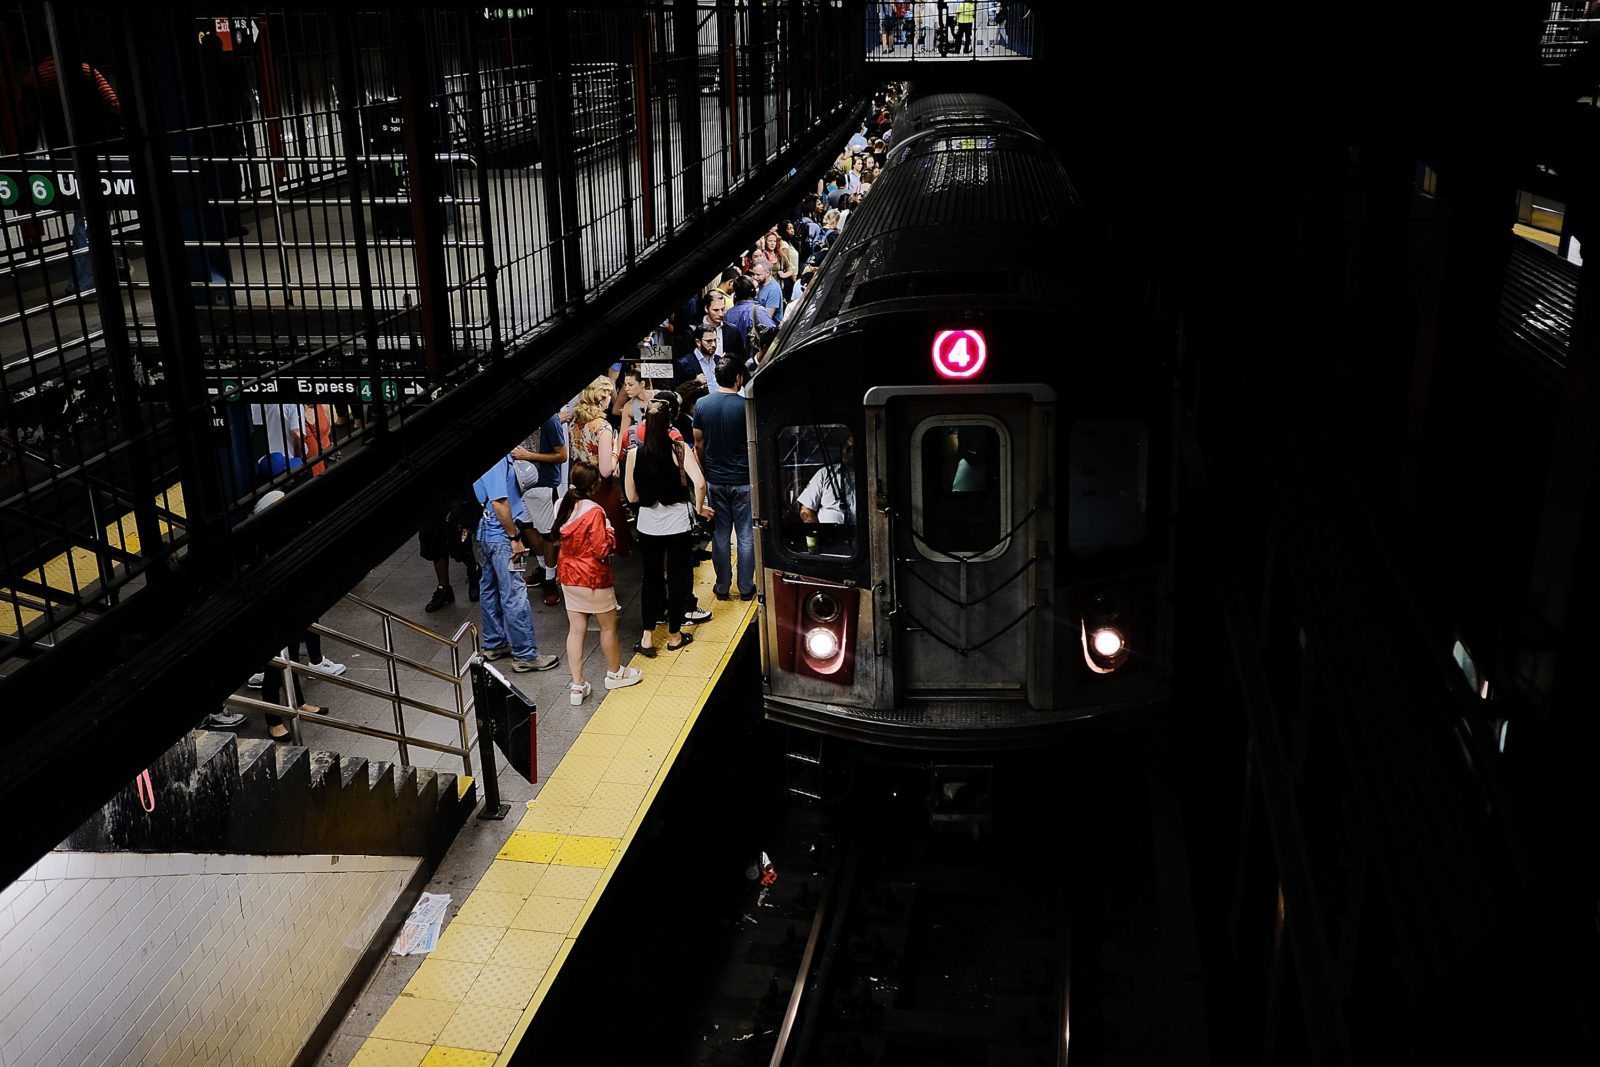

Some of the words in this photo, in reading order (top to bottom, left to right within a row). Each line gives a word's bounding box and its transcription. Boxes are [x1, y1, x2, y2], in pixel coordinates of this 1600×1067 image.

[215, 19, 230, 33] Exit
[241, 379, 278, 393] Local
[297, 380, 355, 395] Express
